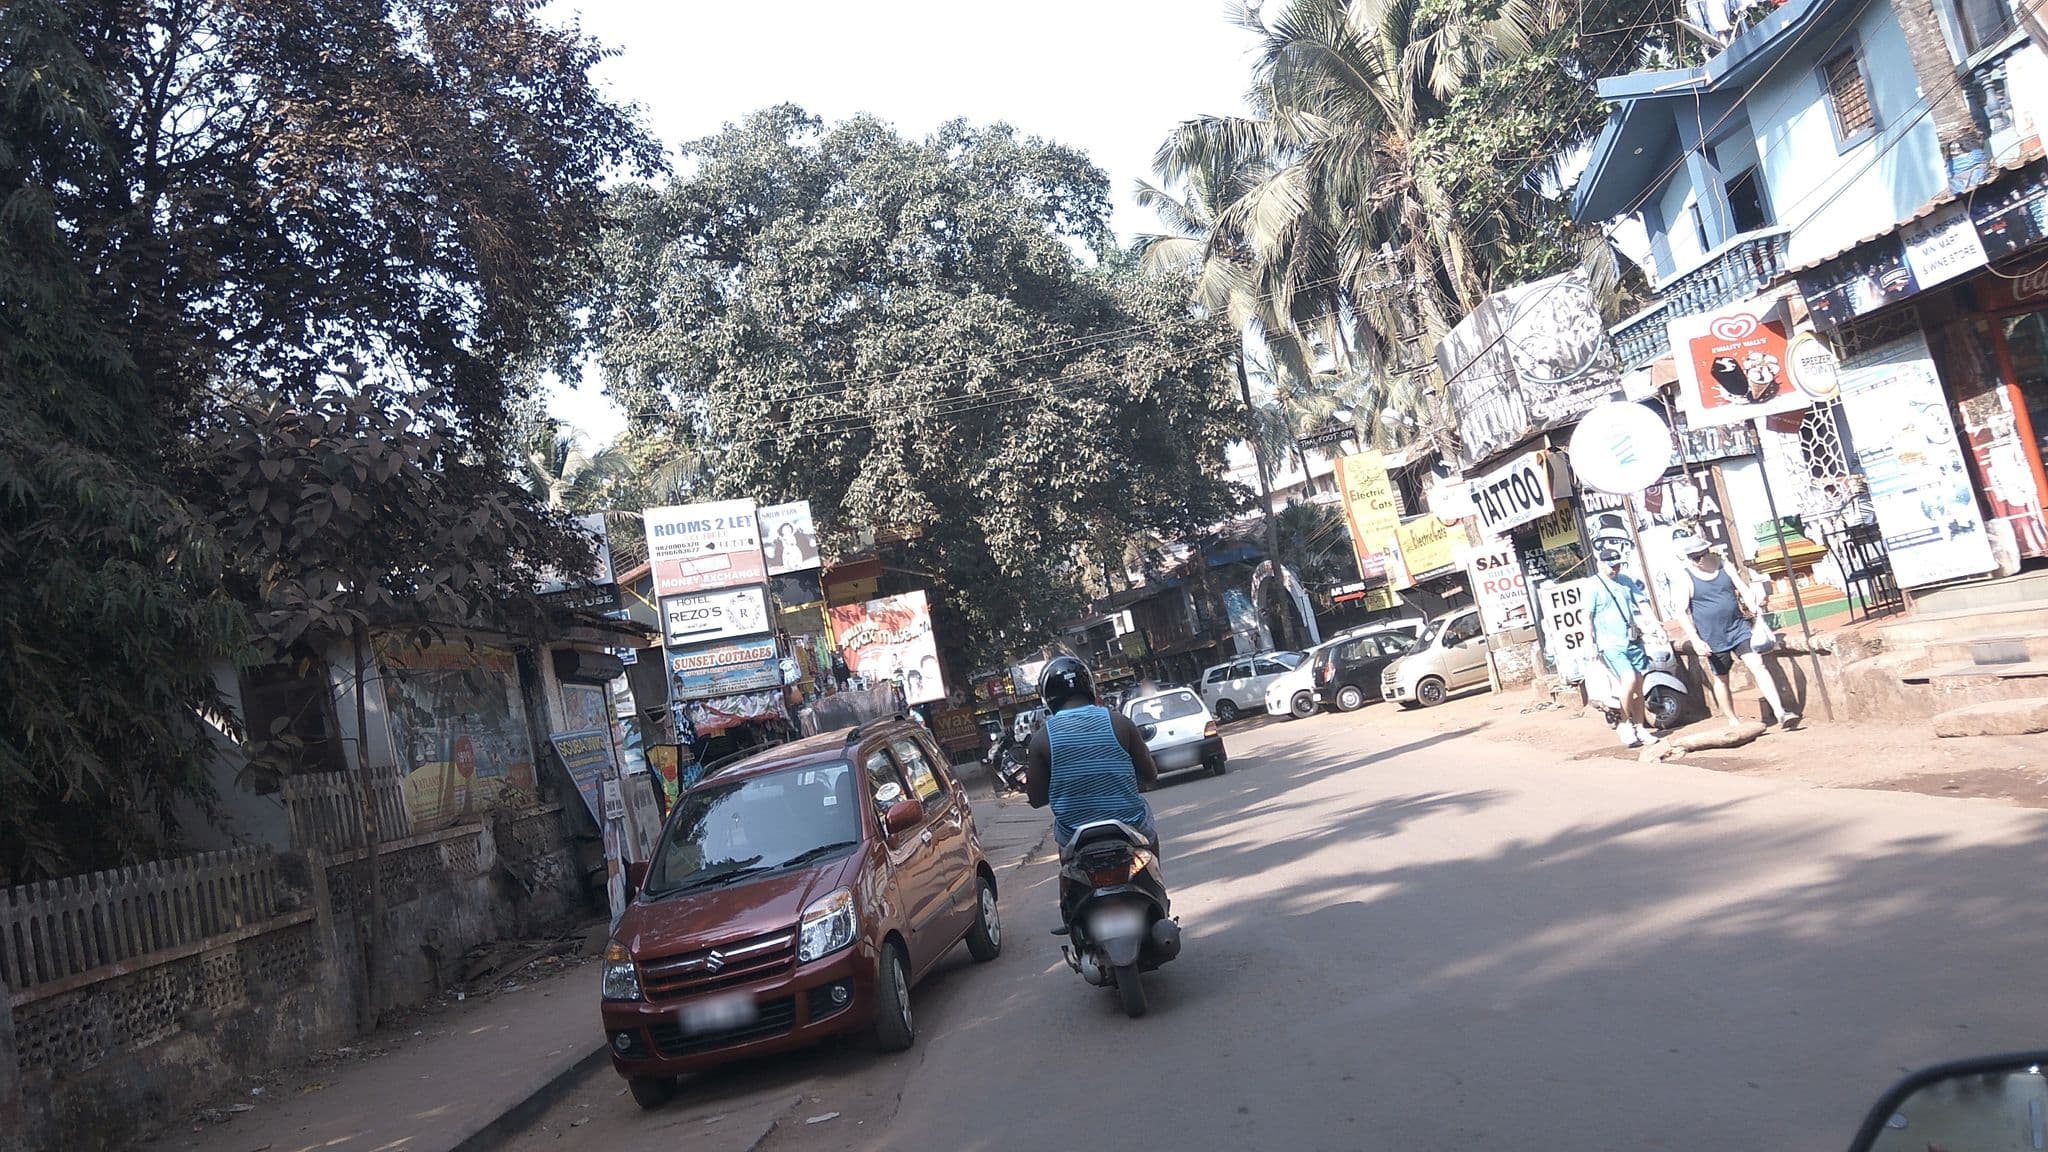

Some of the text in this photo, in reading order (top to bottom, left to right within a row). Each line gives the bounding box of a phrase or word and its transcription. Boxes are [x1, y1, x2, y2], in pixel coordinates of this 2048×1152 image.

[1801, 354, 1833, 367] BREEZER
[1318, 433, 1340, 445] FOOT
[1349, 487, 1386, 503] Electric
[1471, 466, 1545, 528] TATTOO
[1371, 498, 1393, 511] Cats
[654, 518, 712, 537] ROOMS
[715, 517, 726, 530] 2
[729, 514, 753, 529] LET
[1539, 512, 1562, 540] FISH
[1476, 552, 1511, 571] SAI
[661, 567, 761, 589] MONEY EXCHANGE
[676, 595, 710, 607] HOTEL
[669, 606, 722, 623] REZO'S
[740, 608, 749, 618] R
[673, 653, 718, 670] SUNSET
[717, 645, 772, 664] COTTAGES
[558, 736, 588, 757] SCUBA
